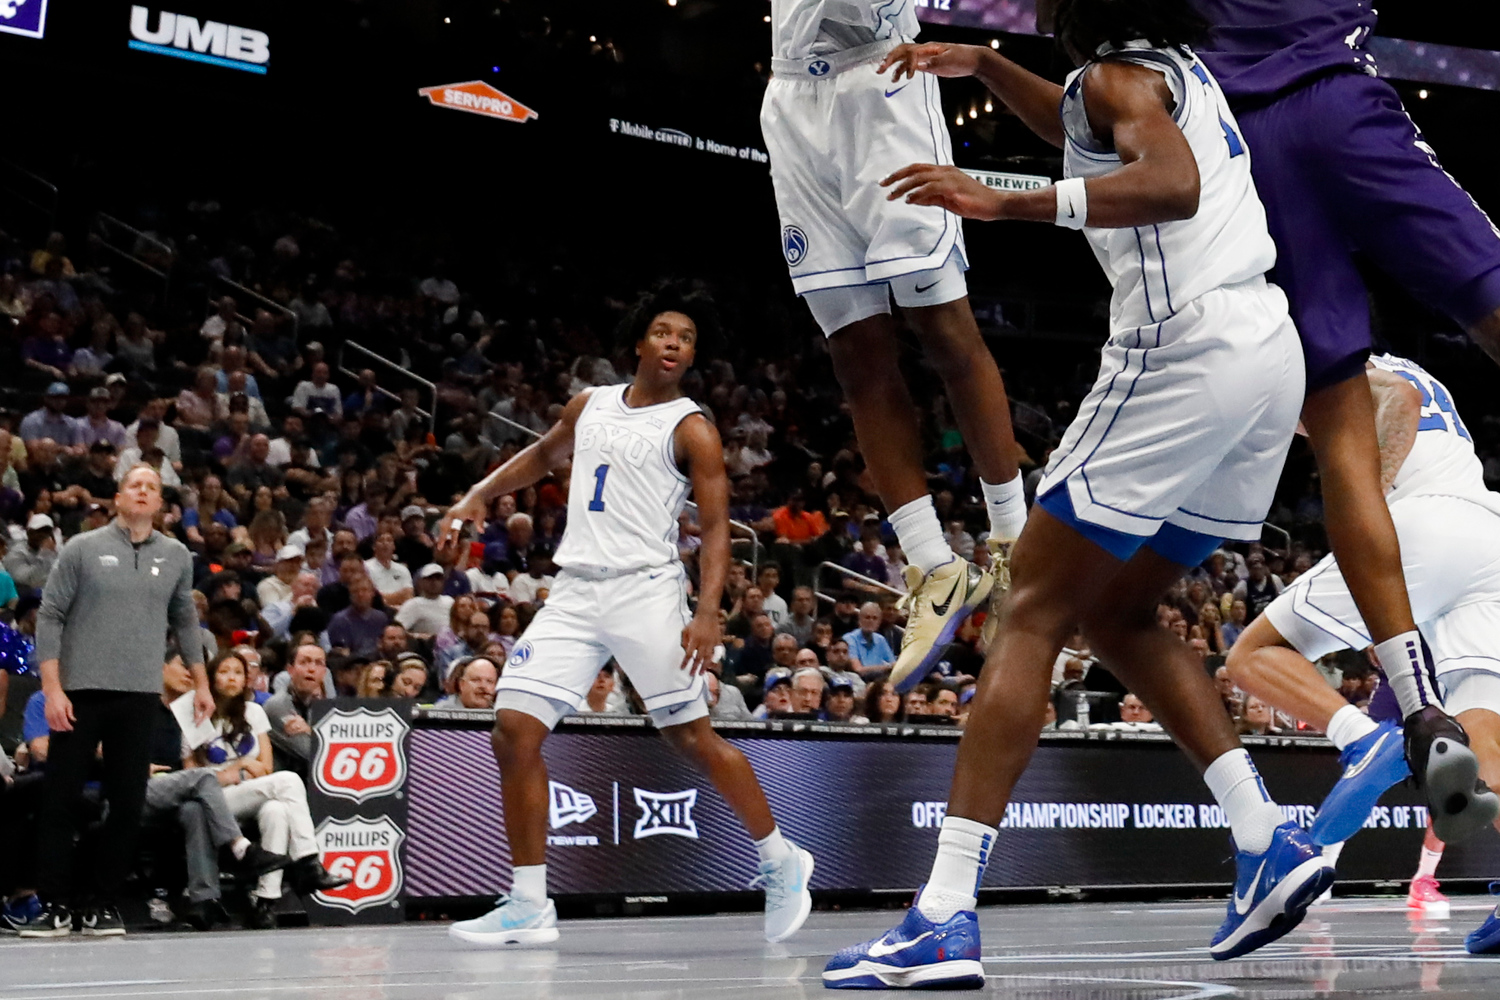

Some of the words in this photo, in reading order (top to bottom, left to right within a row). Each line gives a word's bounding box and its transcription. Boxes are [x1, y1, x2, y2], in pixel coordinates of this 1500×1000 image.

[130, 4, 270, 64] UMB
[444, 89, 513, 116] SERVPRO
[620, 120, 653, 140] Mobile
[655, 131, 689, 147] CENTER
[706, 139, 737, 157] Home
[739, 147, 750, 159] of
[751, 149, 768, 163] the
[985, 176, 1040, 190] BREWED
[577, 422, 655, 470] BYU
[588, 464, 610, 512] 1
[330, 723, 394, 738] PHILLIPS
[330, 746, 389, 781] 66
[912, 802, 947, 828] OFF
[1133, 804, 1197, 828] LOCKER
[1199, 804, 1231, 828] ROO
[1278, 805, 1316, 828] IRTS
[1362, 806, 1391, 828] APS
[1393, 806, 1411, 828] OF
[325, 831, 389, 847] PHILLIPS
[327, 855, 385, 890] 66
